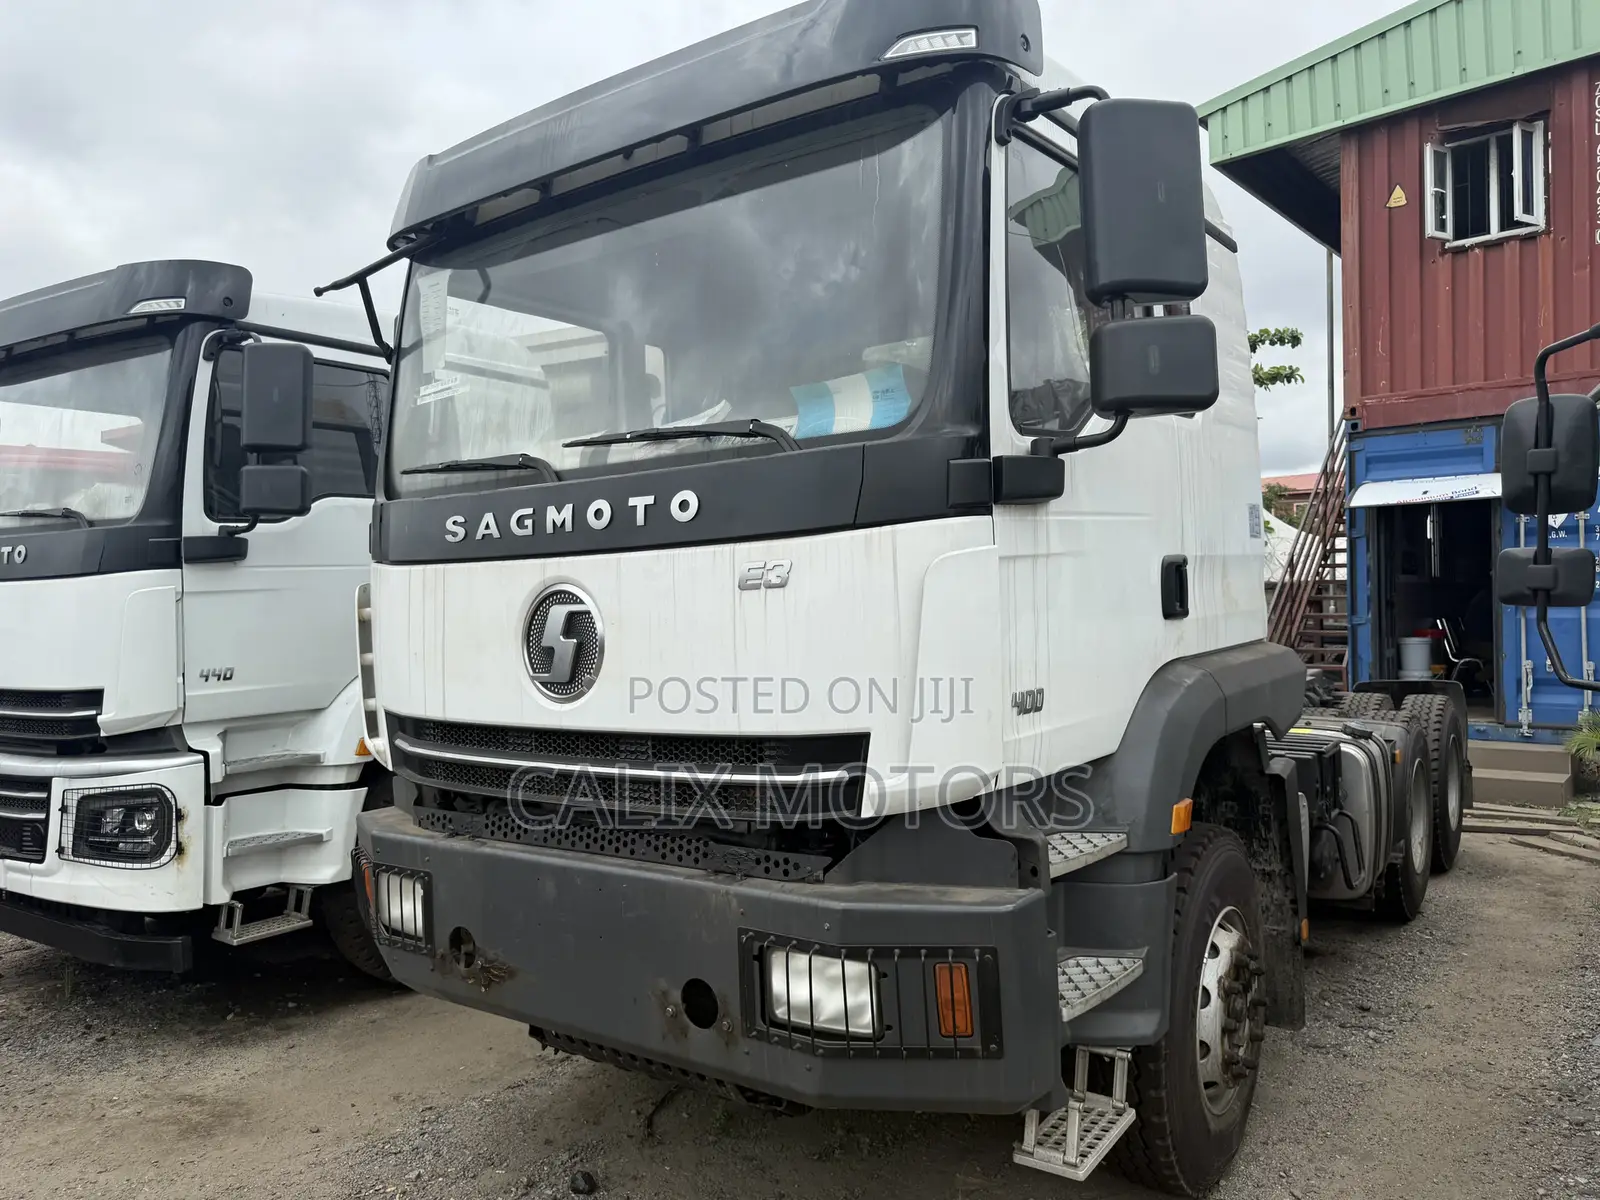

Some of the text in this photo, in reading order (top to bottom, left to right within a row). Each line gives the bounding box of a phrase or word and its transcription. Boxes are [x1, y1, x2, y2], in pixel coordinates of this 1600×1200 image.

[444, 489, 700, 544] SAGMOTO
[0, 544, 27, 564] TO
[738, 559, 793, 591] E3
[199, 666, 235, 683] 440
[1011, 688, 1045, 716] 400
